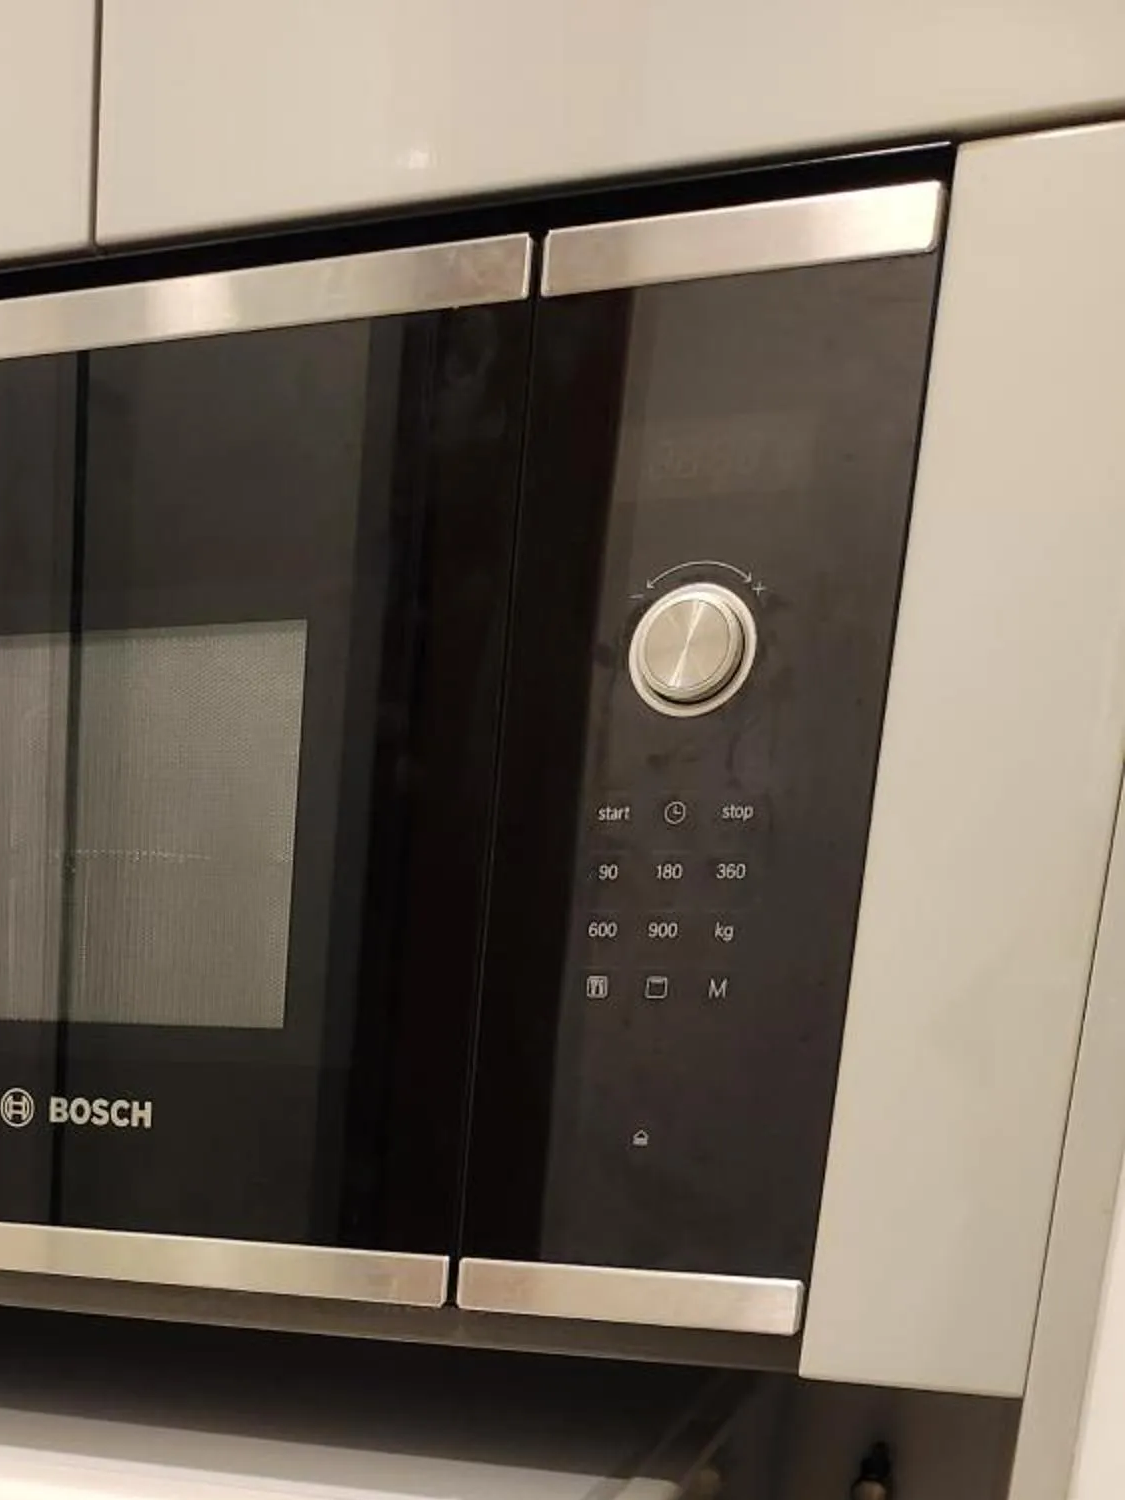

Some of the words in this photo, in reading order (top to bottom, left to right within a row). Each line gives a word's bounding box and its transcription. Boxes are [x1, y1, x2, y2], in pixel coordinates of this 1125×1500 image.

[598, 805, 631, 822] start
[722, 802, 754, 822] stop
[598, 863, 619, 880] 90
[656, 863, 683, 880] 180
[715, 863, 747, 880] 360
[588, 921, 618, 938] 600
[648, 921, 679, 939] 900
[714, 921, 735, 941] kg
[708, 977, 728, 999] M
[48, 1095, 153, 1129] BOSCH
